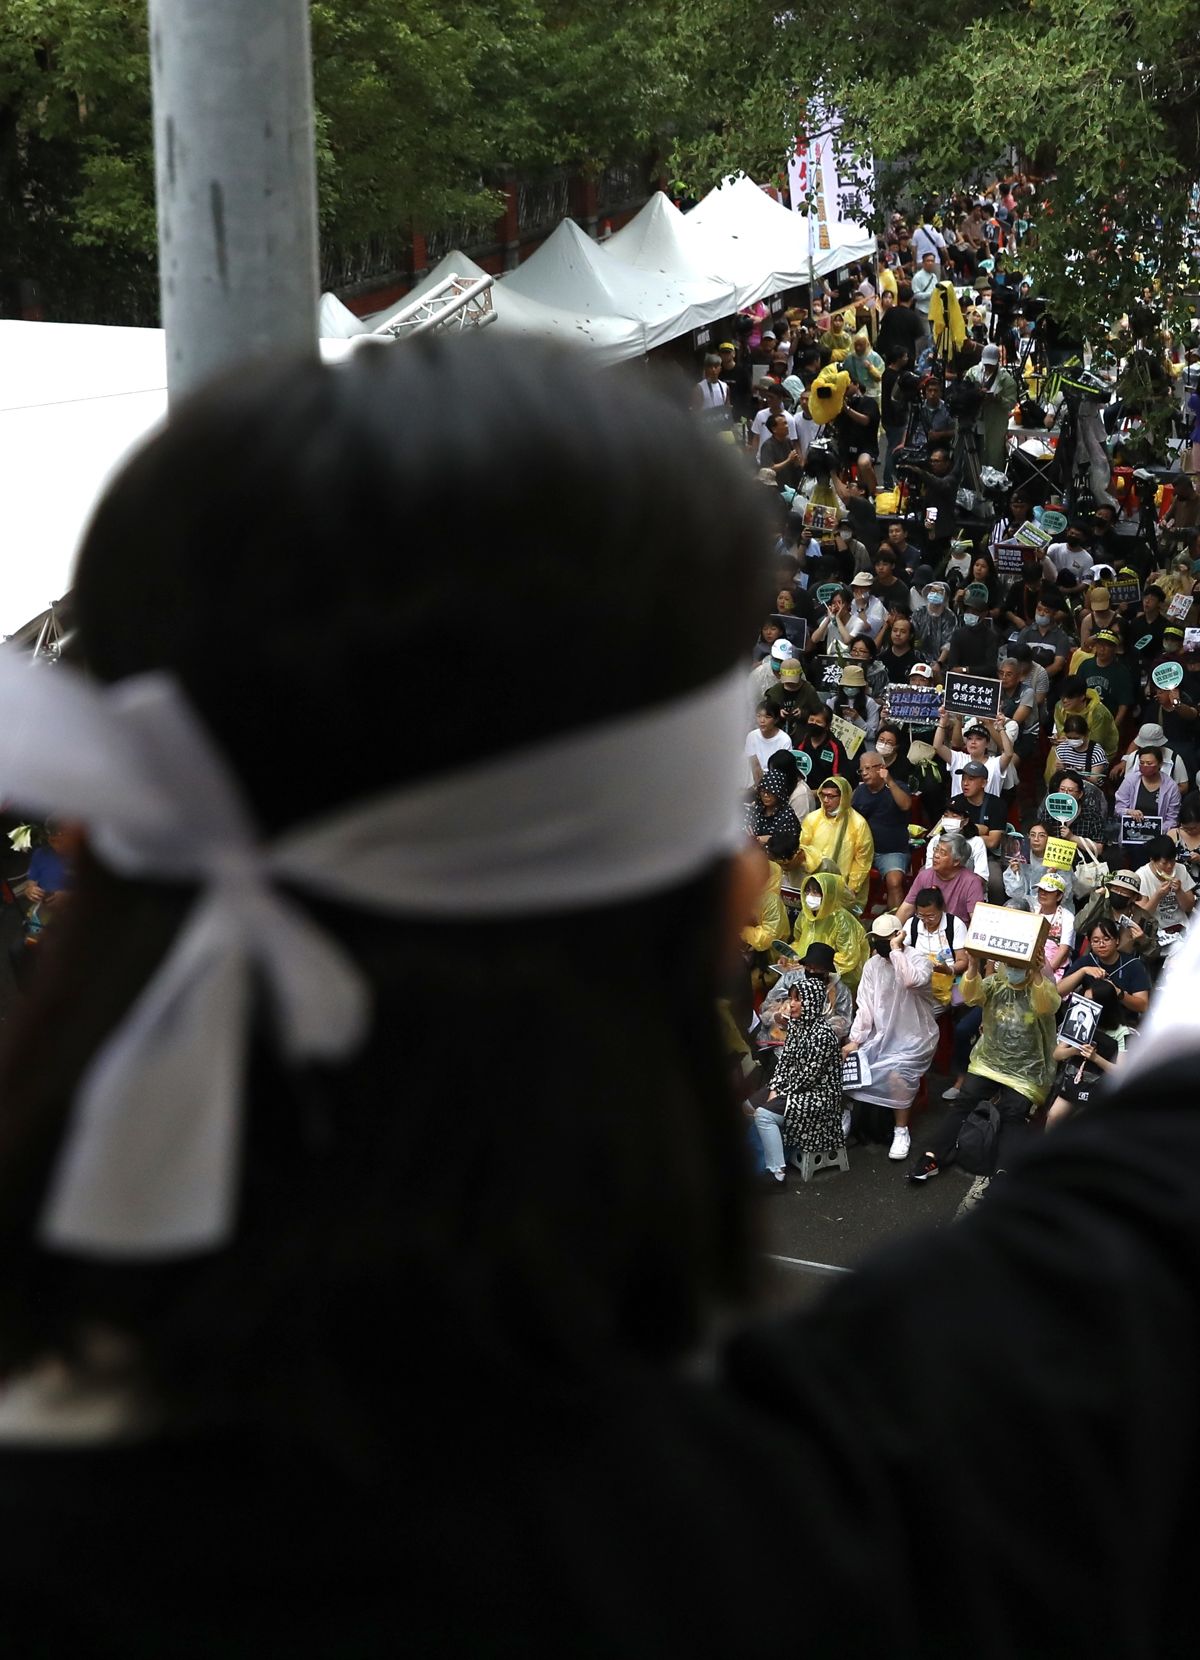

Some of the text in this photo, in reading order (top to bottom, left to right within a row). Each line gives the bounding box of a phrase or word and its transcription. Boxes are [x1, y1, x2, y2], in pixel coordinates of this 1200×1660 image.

[952, 682, 994, 697] 國民黨不倒
[952, 691, 993, 706] 台灣不會好
